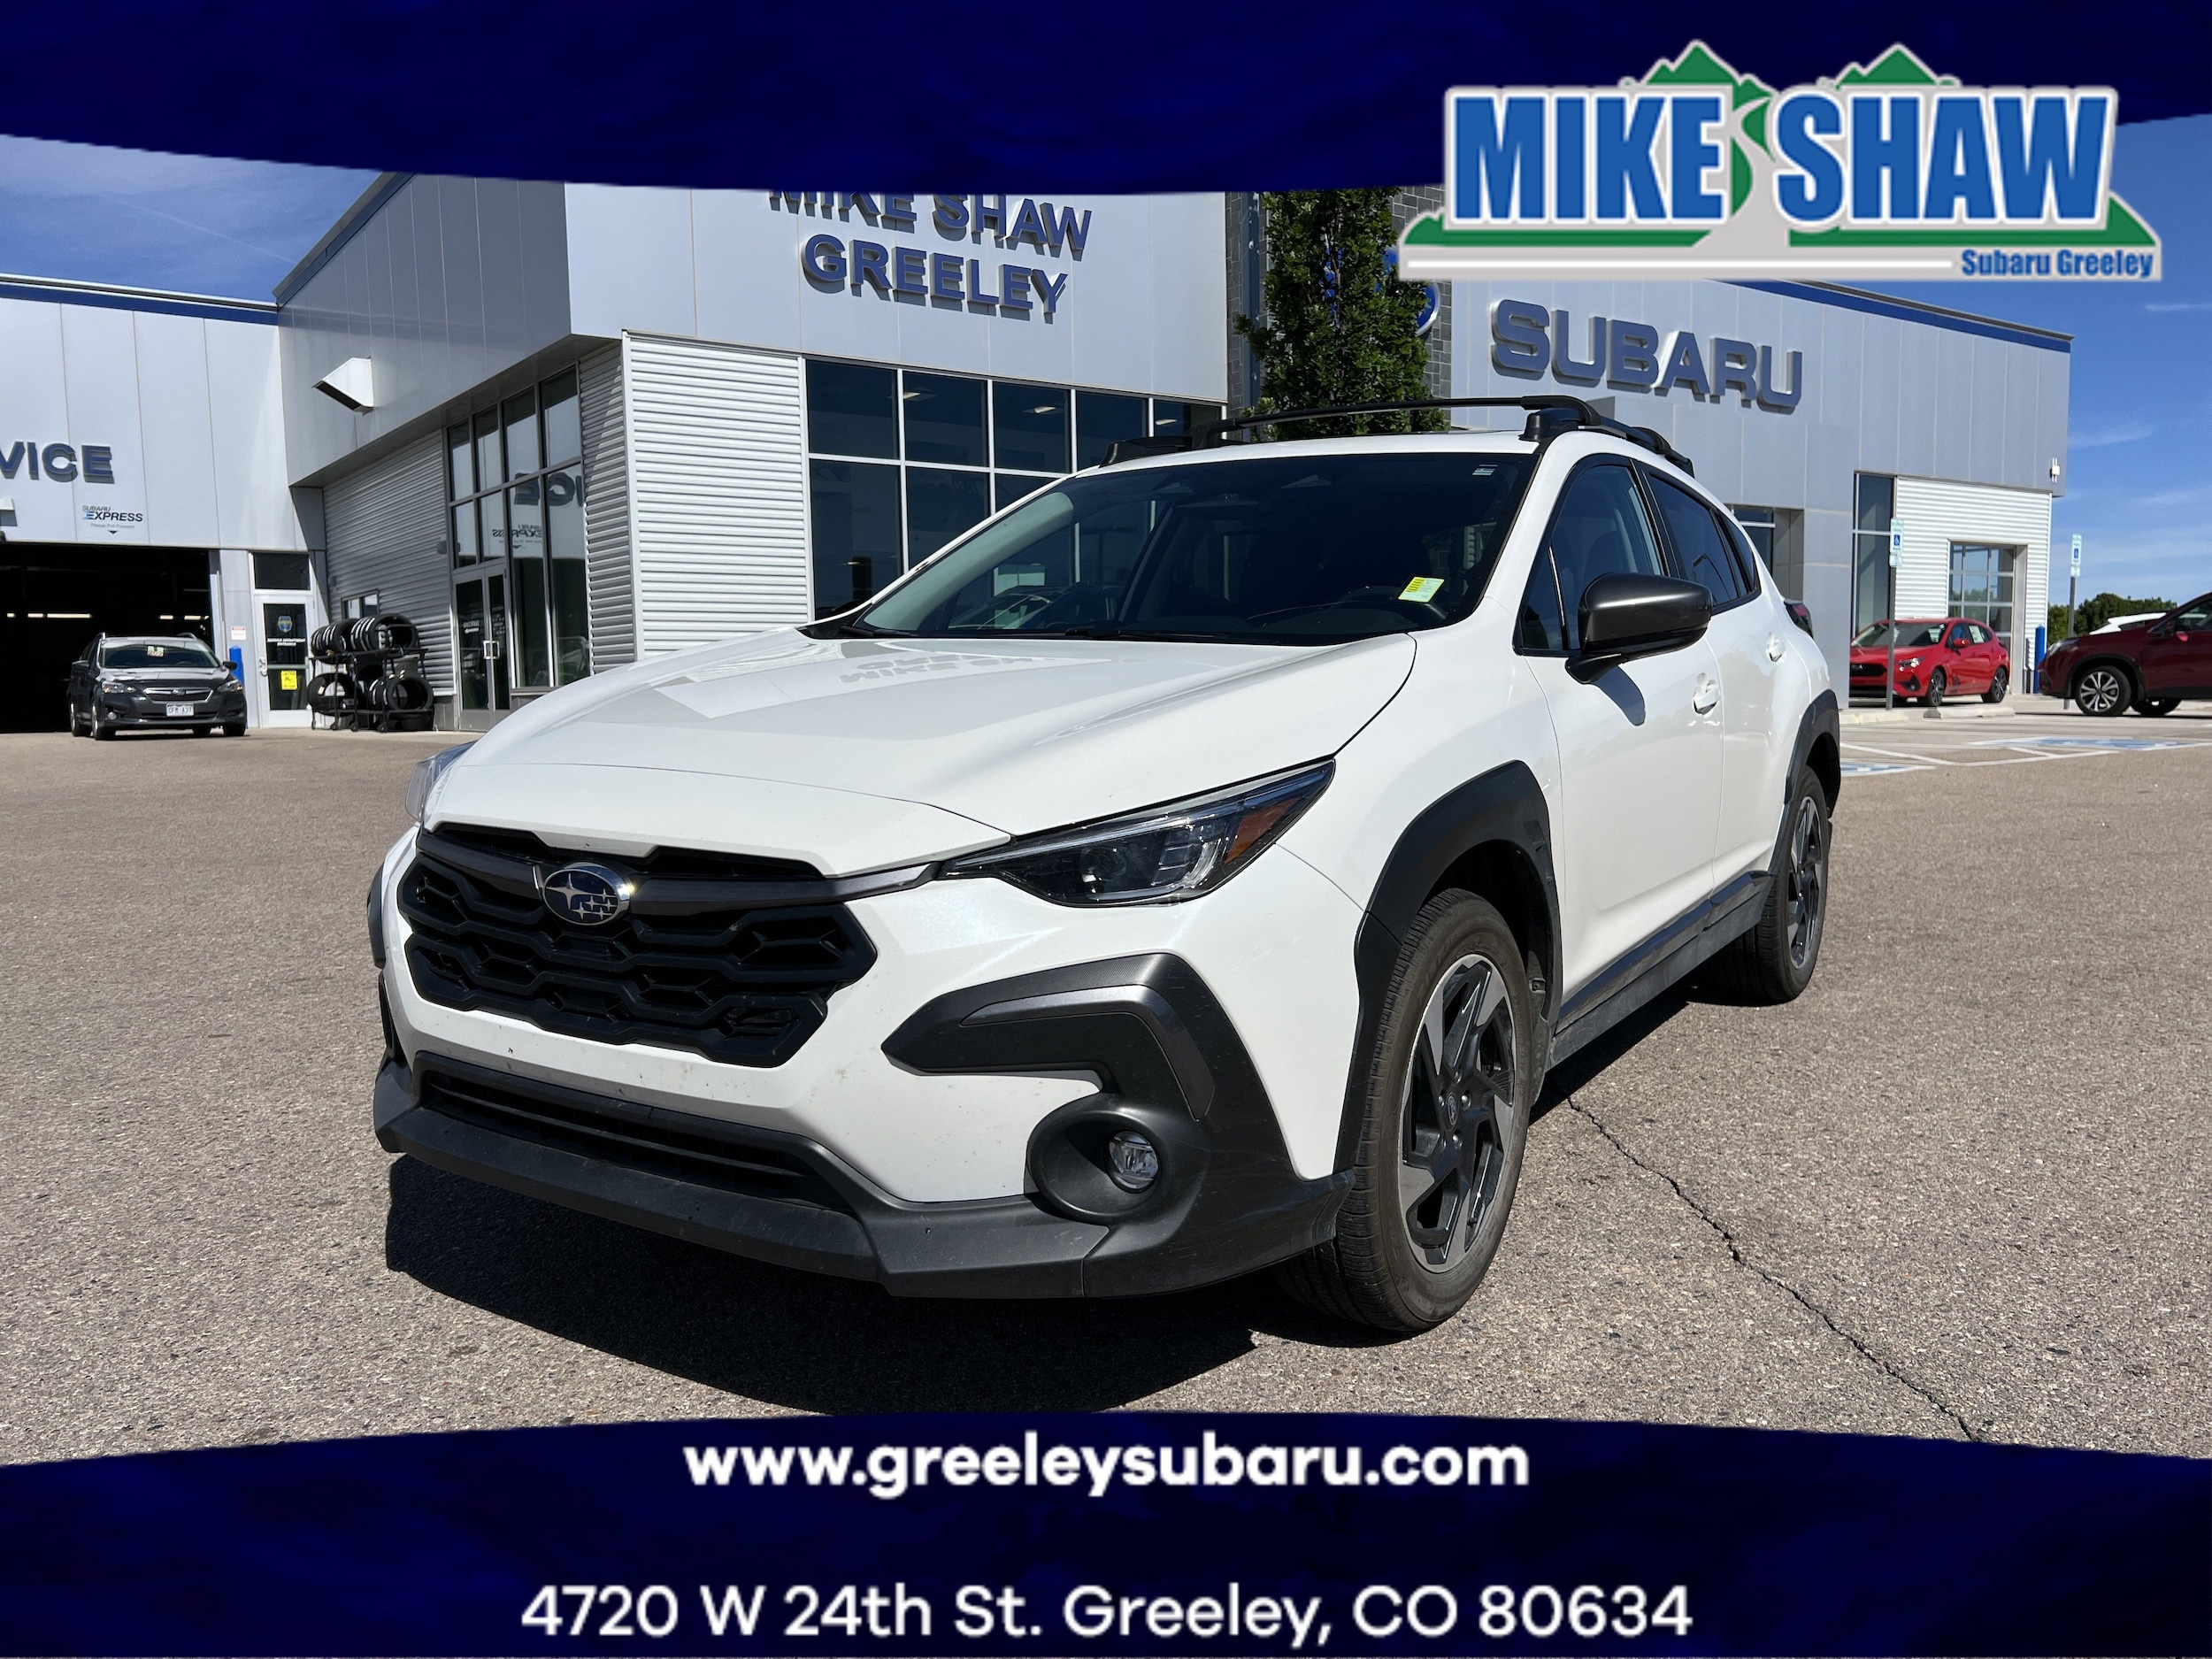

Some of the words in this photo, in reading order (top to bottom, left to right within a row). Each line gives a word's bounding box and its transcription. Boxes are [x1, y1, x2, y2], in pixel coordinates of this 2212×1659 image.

[933, 192, 1092, 250] SHAW
[801, 234, 1069, 315] GREELEY
[1491, 299, 1802, 411] SUBARU
[84, 511, 143, 522] EXPRESS
